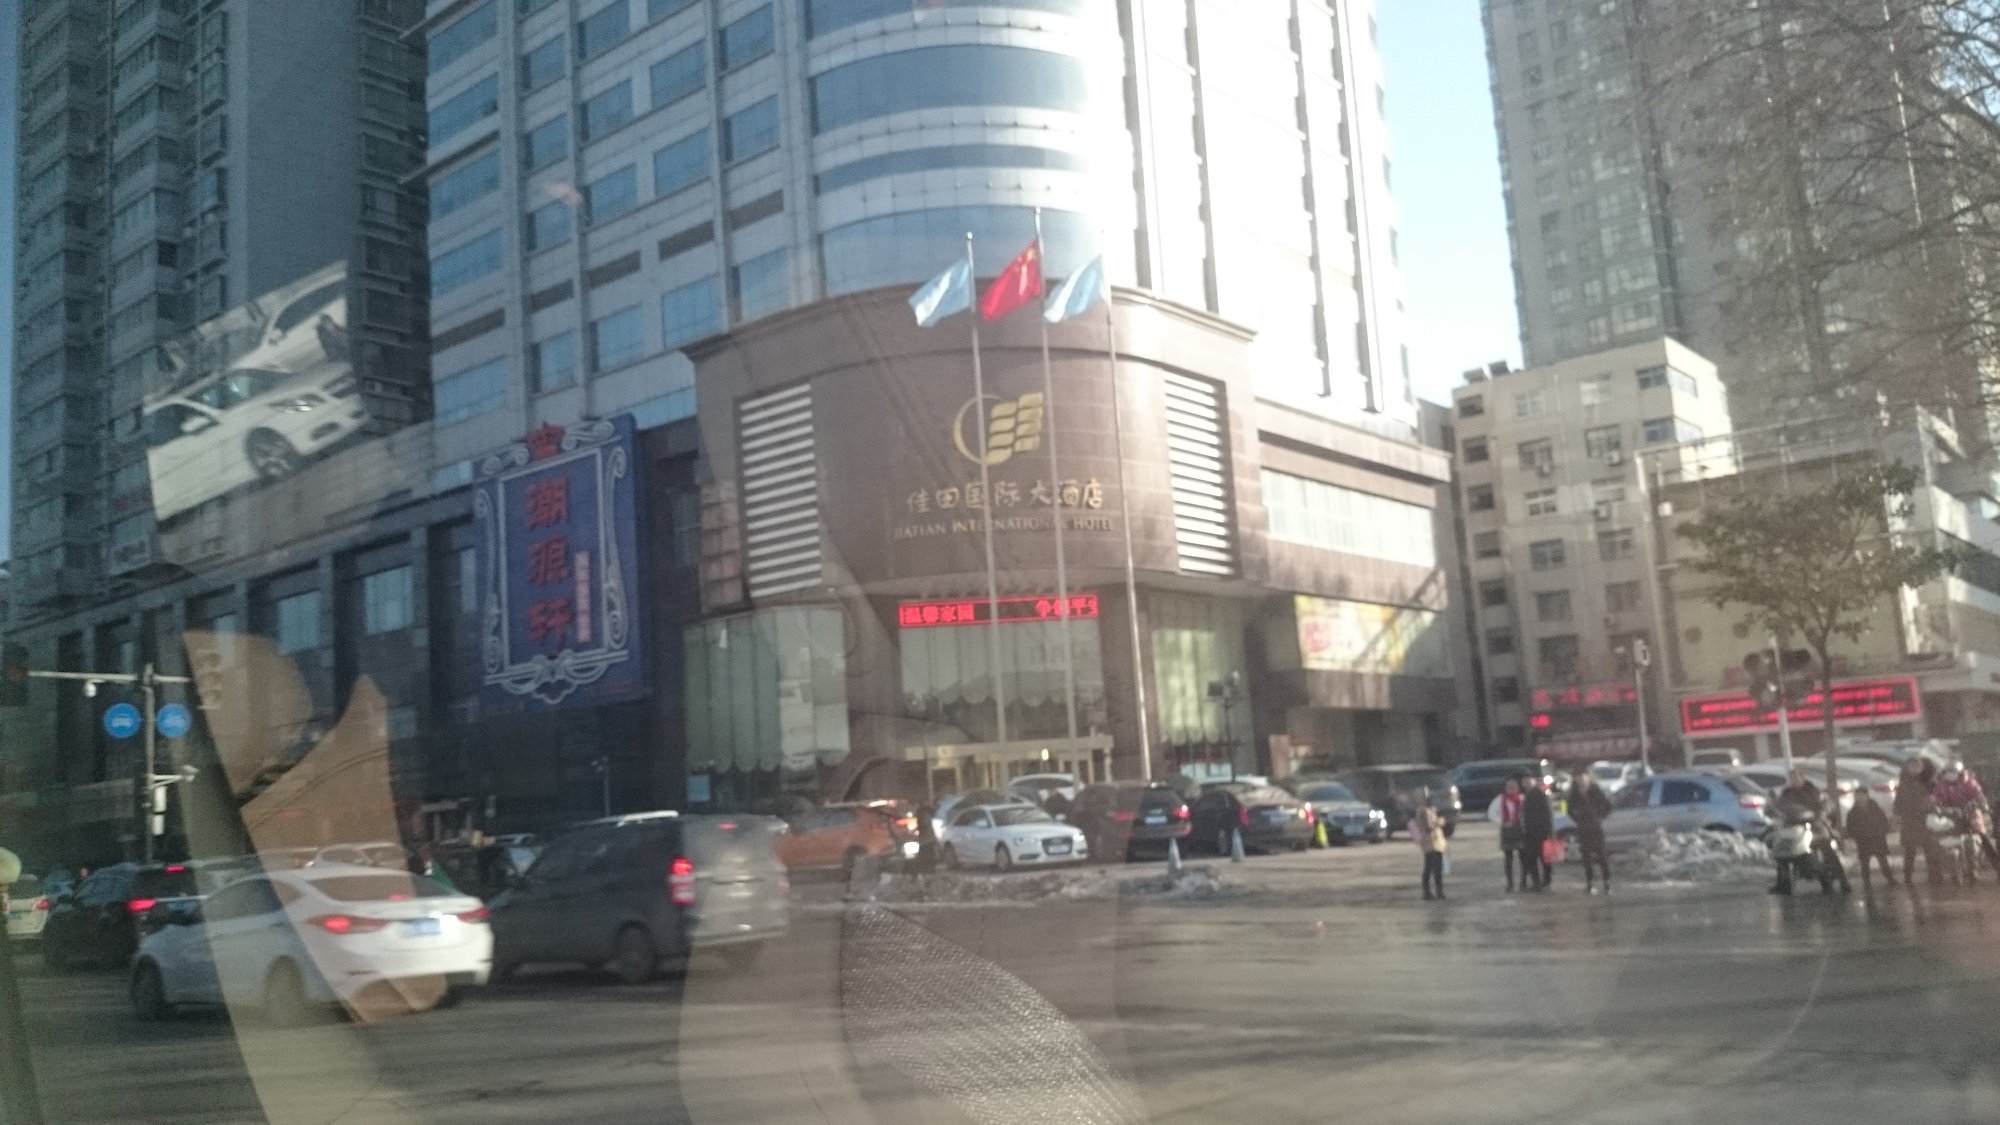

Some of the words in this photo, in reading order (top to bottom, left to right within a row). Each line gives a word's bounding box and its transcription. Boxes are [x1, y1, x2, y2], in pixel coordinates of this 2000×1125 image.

[907, 479, 1104, 513] 佳田国际大酒店
[1073, 516, 1115, 531] HOTEL
